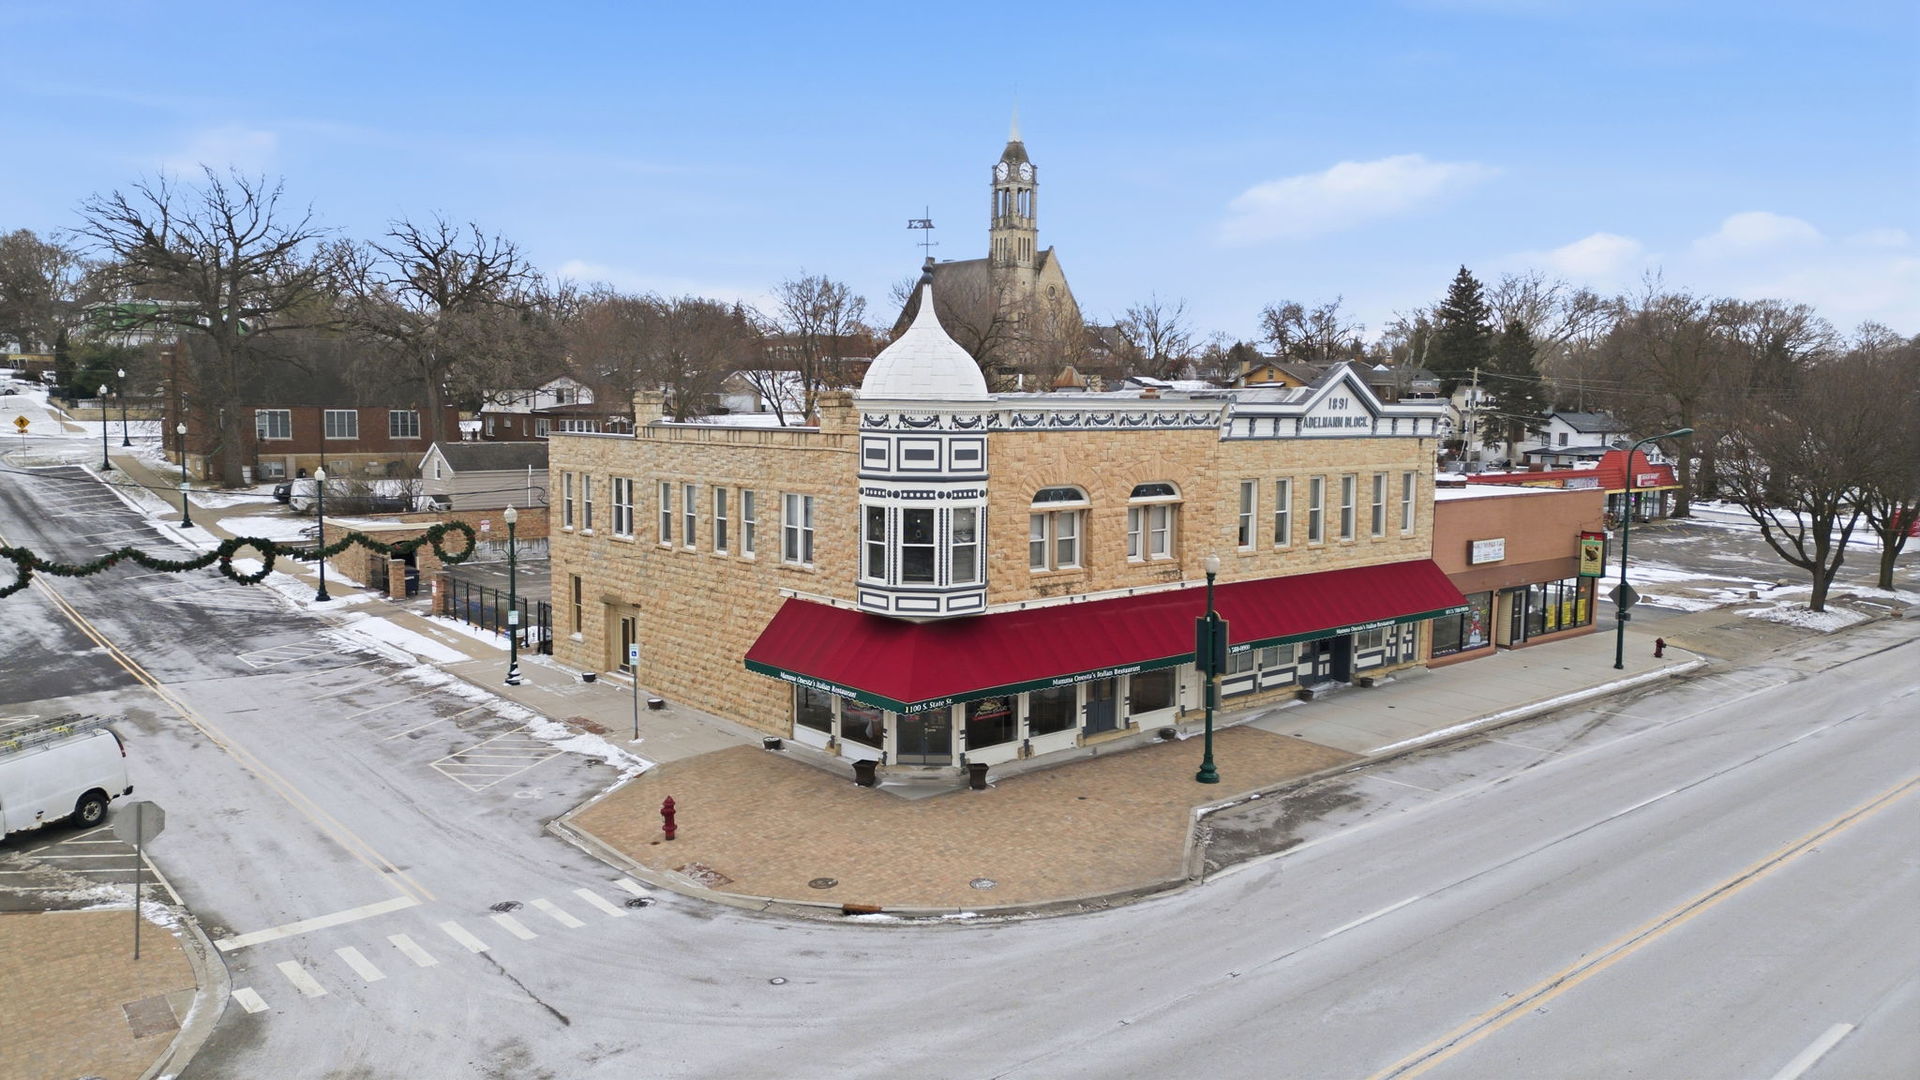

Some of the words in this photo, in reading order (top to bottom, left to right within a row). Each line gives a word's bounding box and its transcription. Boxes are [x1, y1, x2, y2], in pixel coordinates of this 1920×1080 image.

[1328, 397, 1348, 410] 1891
[1114, 665, 1140, 675] Restaurant
[831, 685, 857, 698] Restaurant
[905, 705, 921, 713] 1100
[929, 700, 945, 709] State
